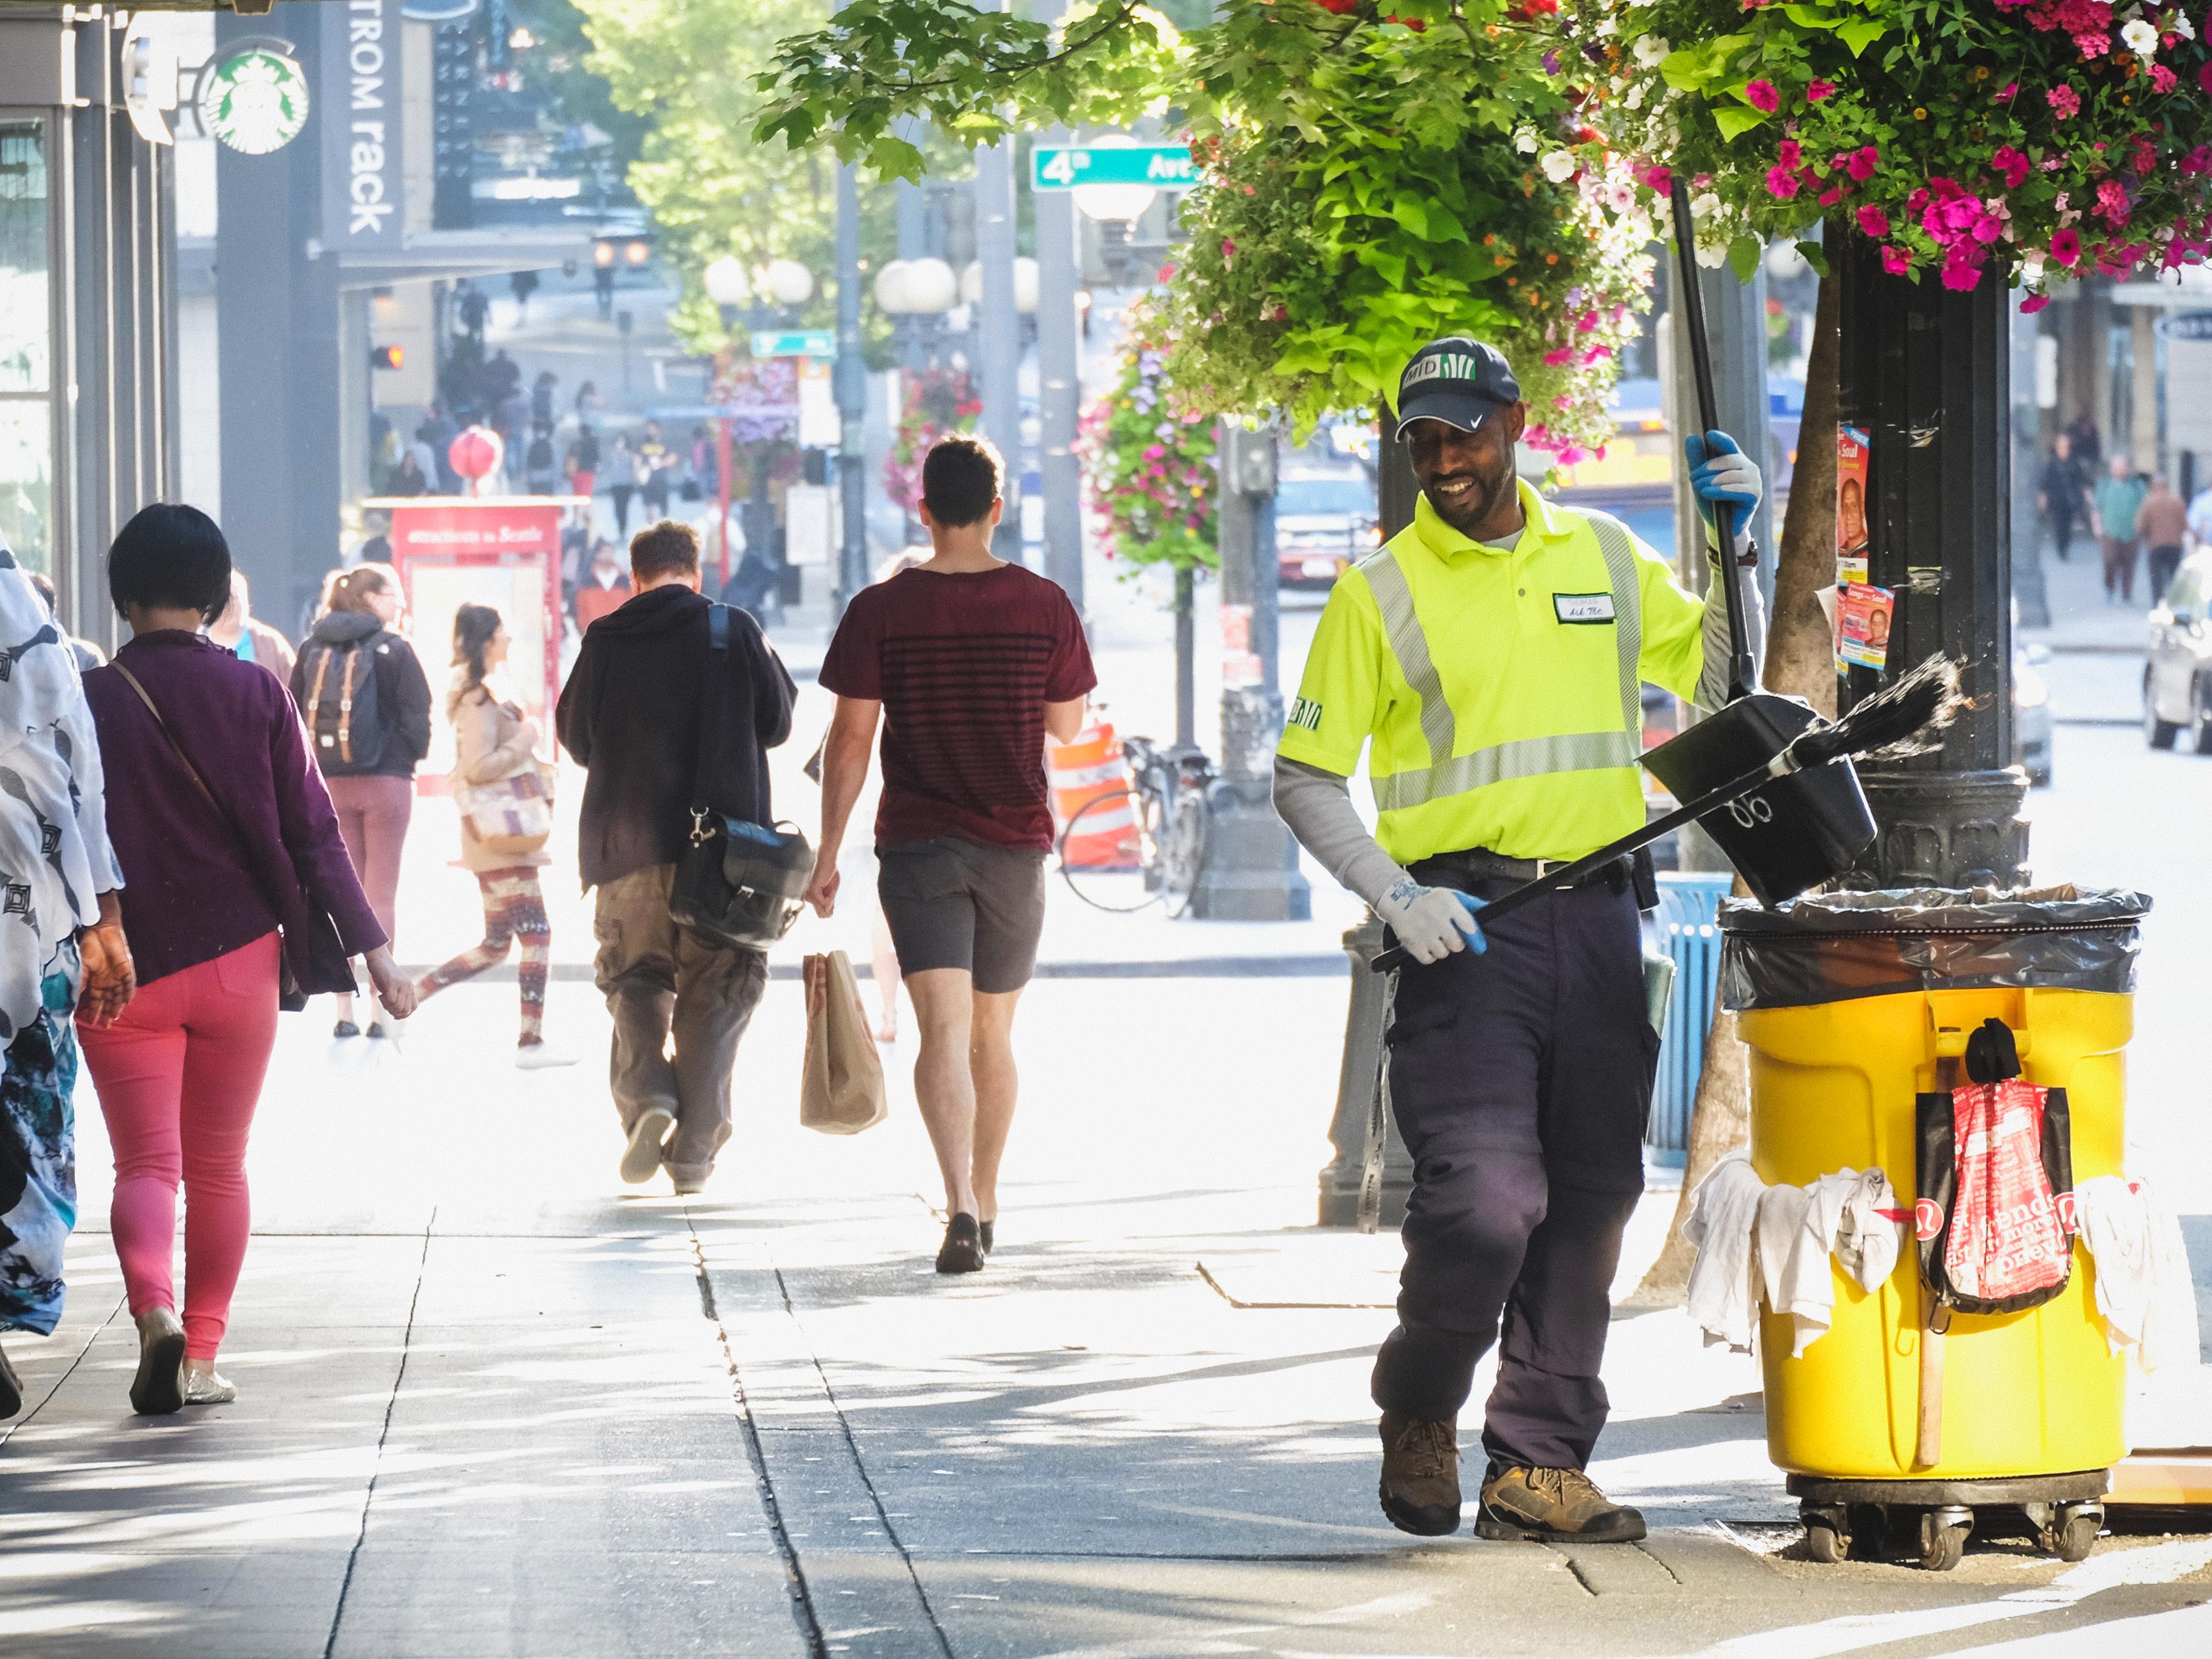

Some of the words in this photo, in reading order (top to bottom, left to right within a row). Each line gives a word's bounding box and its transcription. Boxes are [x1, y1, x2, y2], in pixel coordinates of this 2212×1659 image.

[350, 120, 395, 236] rack
[1405, 359, 1437, 383] MID
[2004, 1215, 2056, 1240] more
